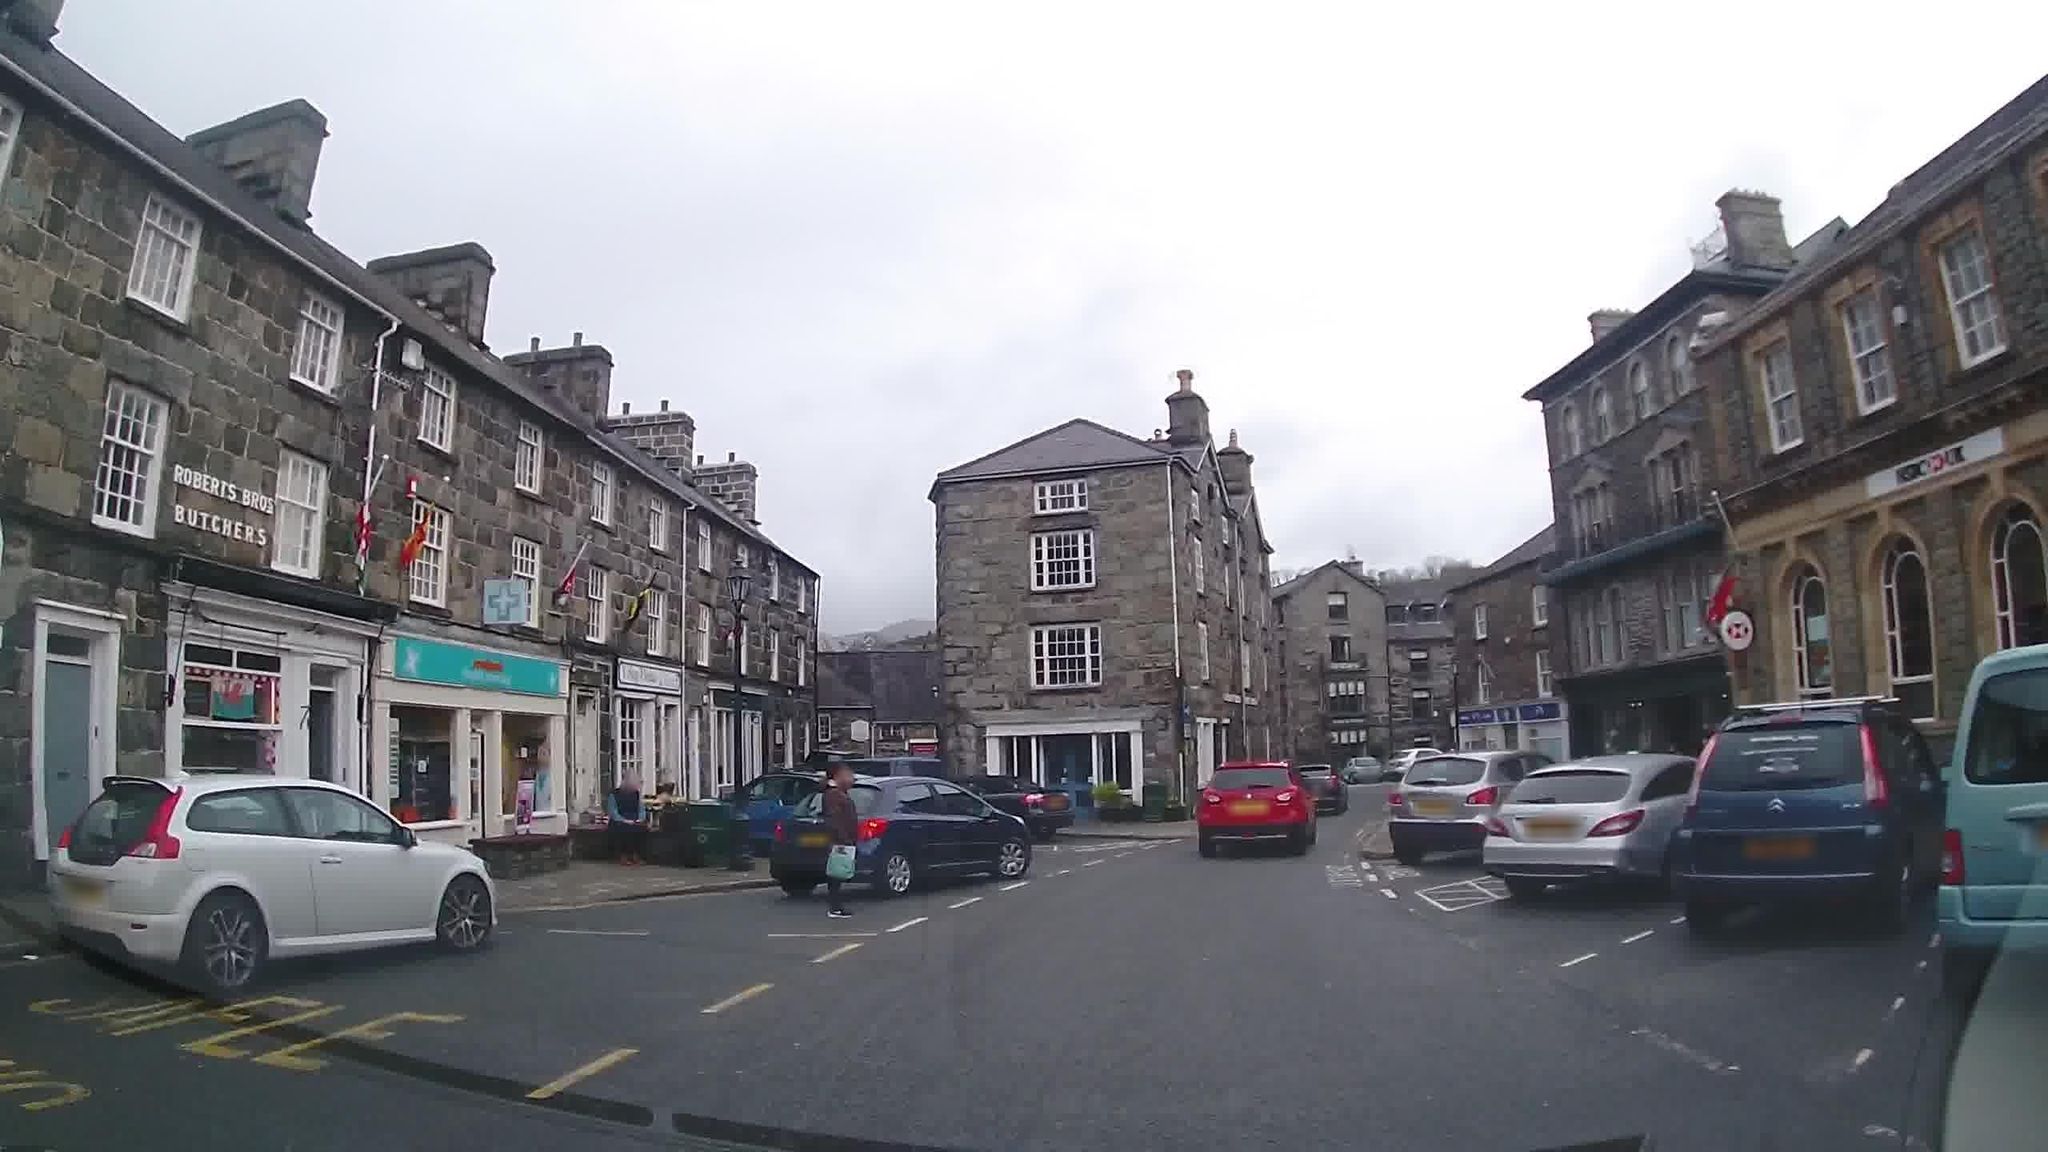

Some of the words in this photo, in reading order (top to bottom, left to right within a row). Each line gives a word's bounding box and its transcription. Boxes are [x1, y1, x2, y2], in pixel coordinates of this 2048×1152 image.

[174, 464, 237, 501] ROBERTS
[242, 488, 275, 515] BROS
[174, 504, 267, 546] BUTCHERS
